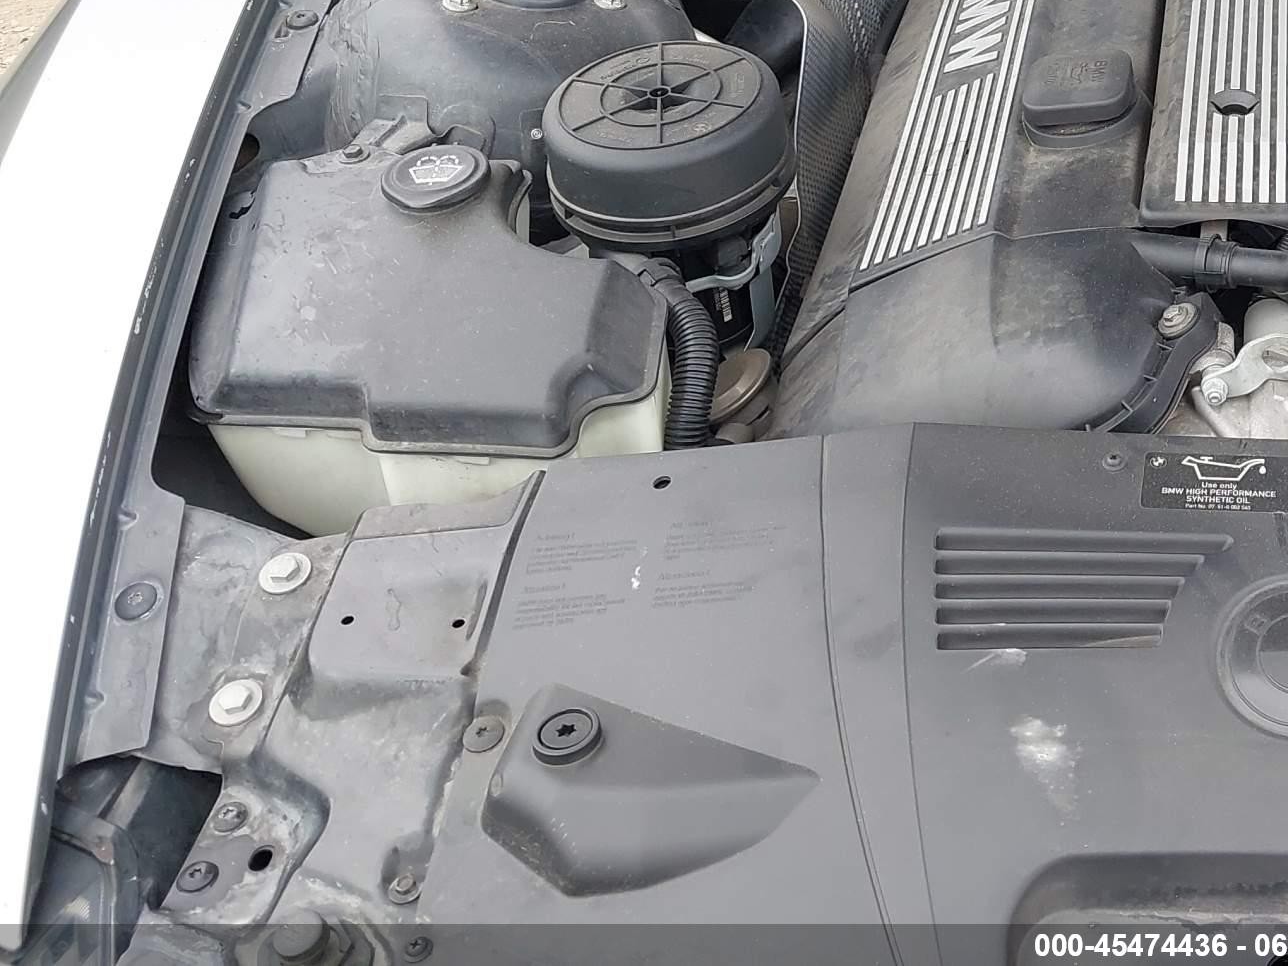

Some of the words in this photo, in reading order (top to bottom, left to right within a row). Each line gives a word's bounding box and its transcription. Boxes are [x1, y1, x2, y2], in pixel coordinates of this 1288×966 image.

[1201, 481, 1218, 489] Use
[1219, 481, 1238, 490] only
[1209, 489, 1277, 498] PERFORMANCE
[1186, 495, 1235, 504] SYNTHETIC
[1236, 496, 1251, 504] OIL
